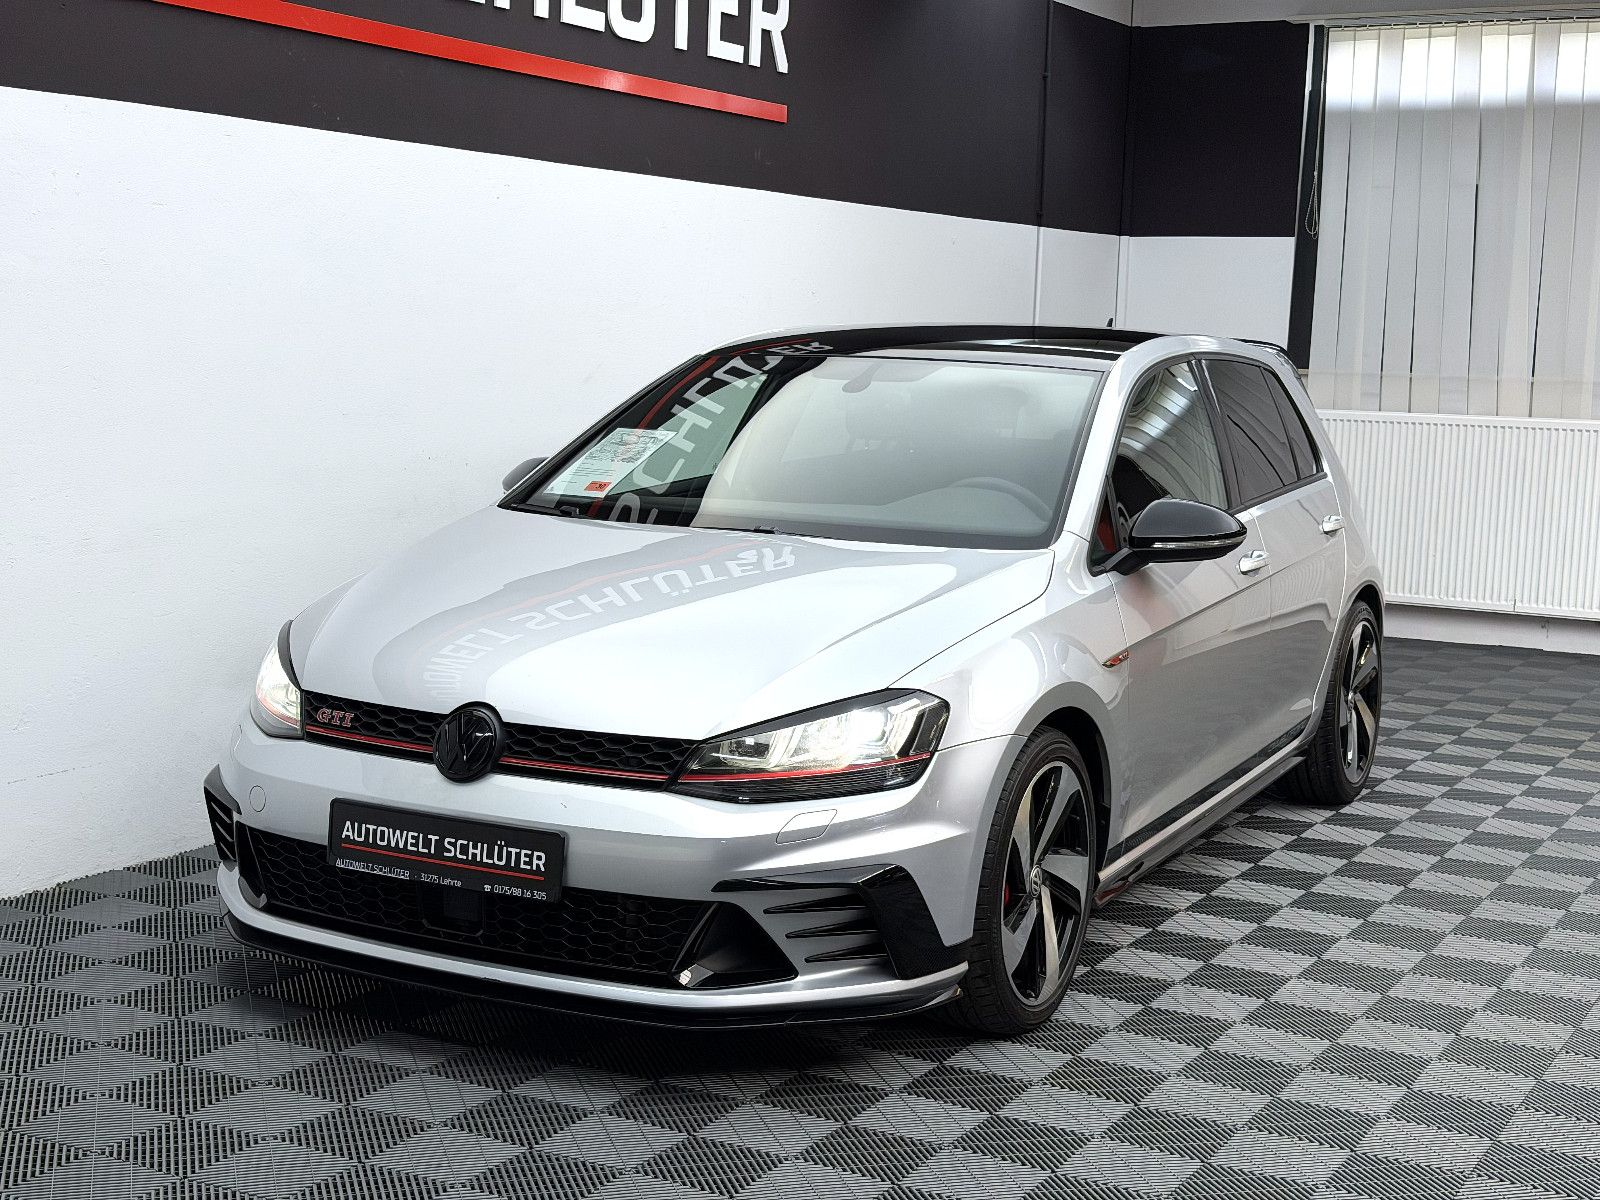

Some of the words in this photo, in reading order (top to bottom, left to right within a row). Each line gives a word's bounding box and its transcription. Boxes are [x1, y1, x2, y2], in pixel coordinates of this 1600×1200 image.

[316, 708, 355, 728] GTI
[341, 820, 439, 854] AUTOWELT
[443, 837, 546, 872] SCHLÜTER
[335, 857, 372, 874] AUTOWELT
[373, 865, 410, 880] SCHLÜTER
[420, 872, 439, 884] 31275
[440, 876, 462, 888] Lehrte
[493, 884, 521, 897] 0175/88
[523, 889, 531, 898] 16
[532, 890, 547, 901] 305
